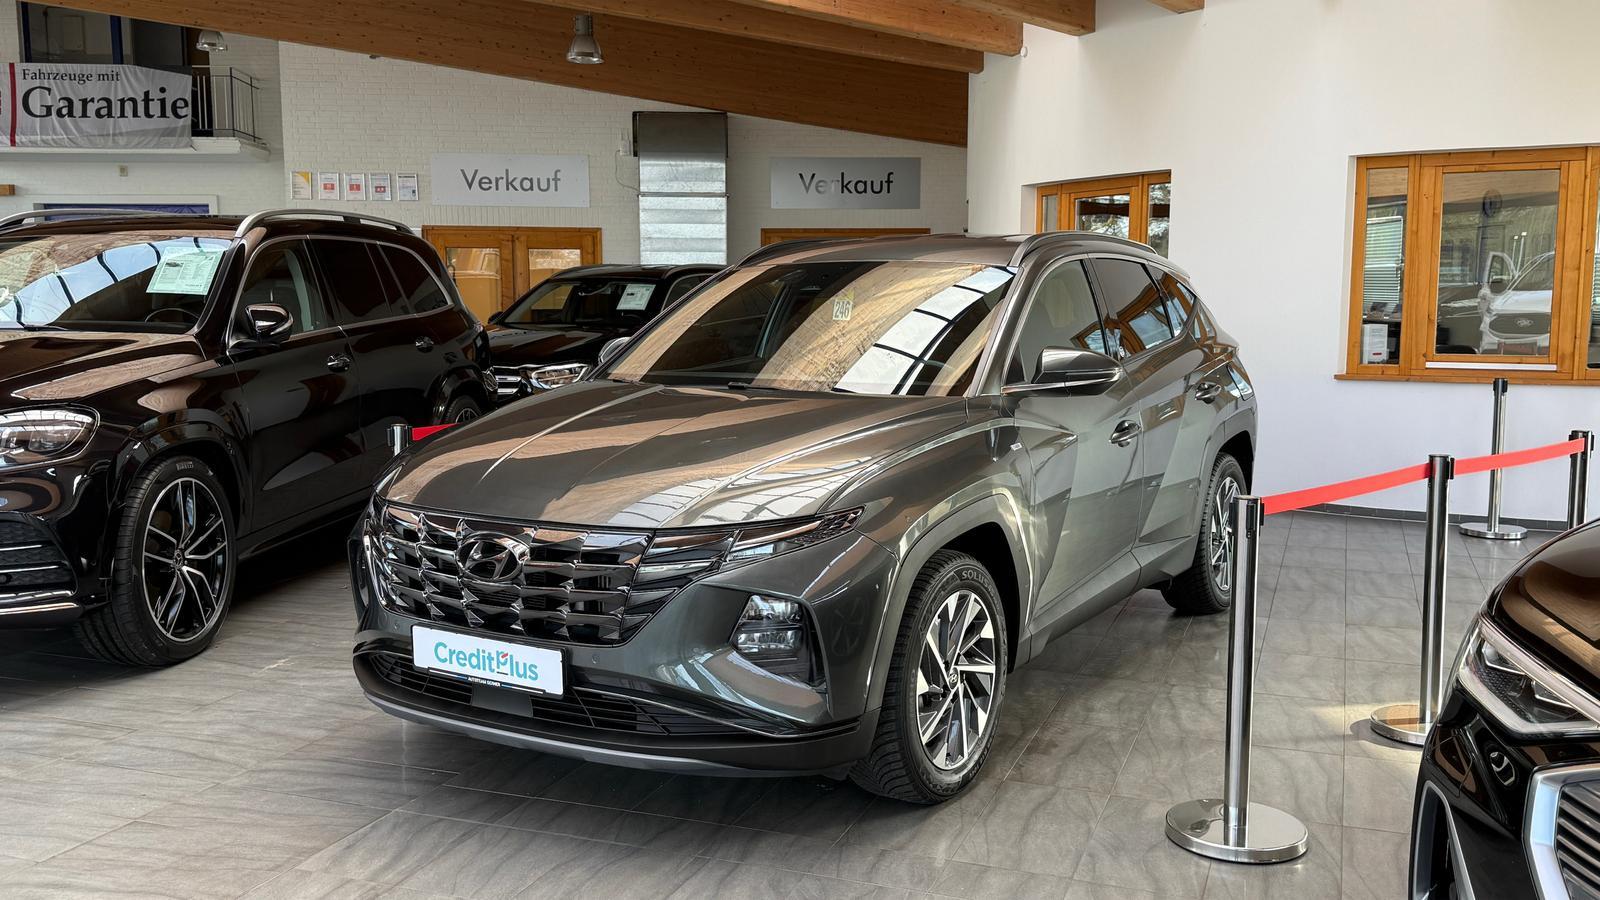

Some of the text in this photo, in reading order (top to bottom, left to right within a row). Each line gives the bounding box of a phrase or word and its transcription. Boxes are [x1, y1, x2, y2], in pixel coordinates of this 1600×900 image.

[22, 68, 120, 85] Fahrzeuge mit
[22, 86, 189, 120] Garantie
[460, 168, 561, 193] Verkauf
[798, 172, 894, 195] Verkauf
[834, 301, 851, 319] 246
[961, 569, 989, 588] SOLUS
[433, 641, 539, 681] CreditPlus
